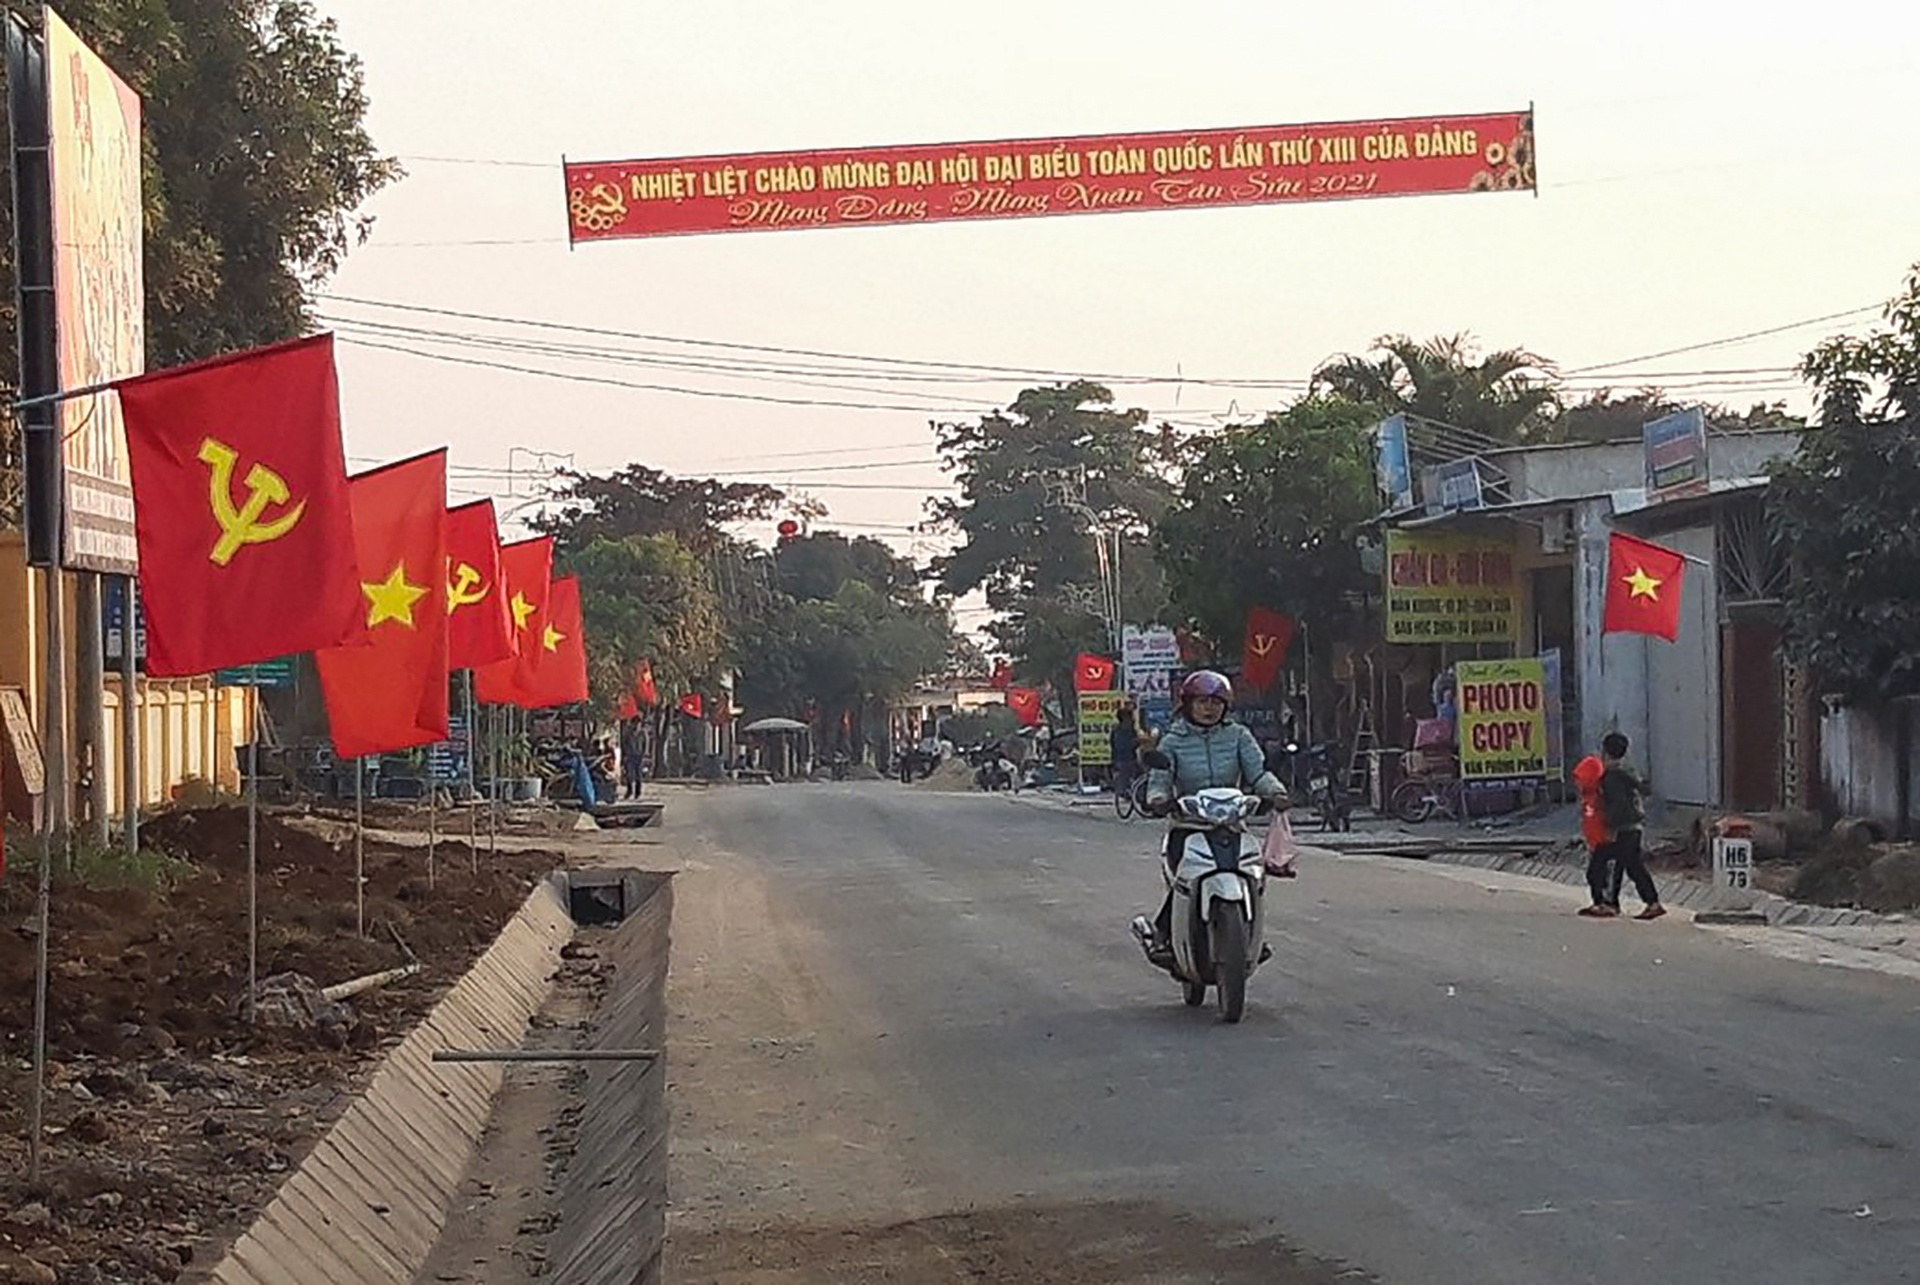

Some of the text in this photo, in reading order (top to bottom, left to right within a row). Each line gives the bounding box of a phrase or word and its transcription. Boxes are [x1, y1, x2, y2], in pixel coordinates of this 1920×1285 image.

[631, 167, 697, 204] NHIỆT
[702, 165, 749, 201] LIỆT
[755, 161, 816, 193] CHÀO
[821, 158, 890, 190] MỪNG
[896, 160, 935, 191] ĐẠI
[940, 153, 978, 188] HỘI
[984, 154, 1023, 186] ĐẠI
[1029, 143, 1081, 179] BIỂU
[1086, 144, 1146, 176] TOÀN
[1153, 138, 1214, 174] QUỐC
[1269, 134, 1315, 166] THỨ
[1318, 136, 1356, 163] XIII
[1363, 126, 1410, 161] CỦA
[1414, 123, 1478, 158] ĐẢNG
[1309, 173, 1378, 193] 2021
[1462, 681, 1539, 714] PHOTO
[1472, 721, 1532, 753] COPY
[1726, 846, 1748, 864] H6
